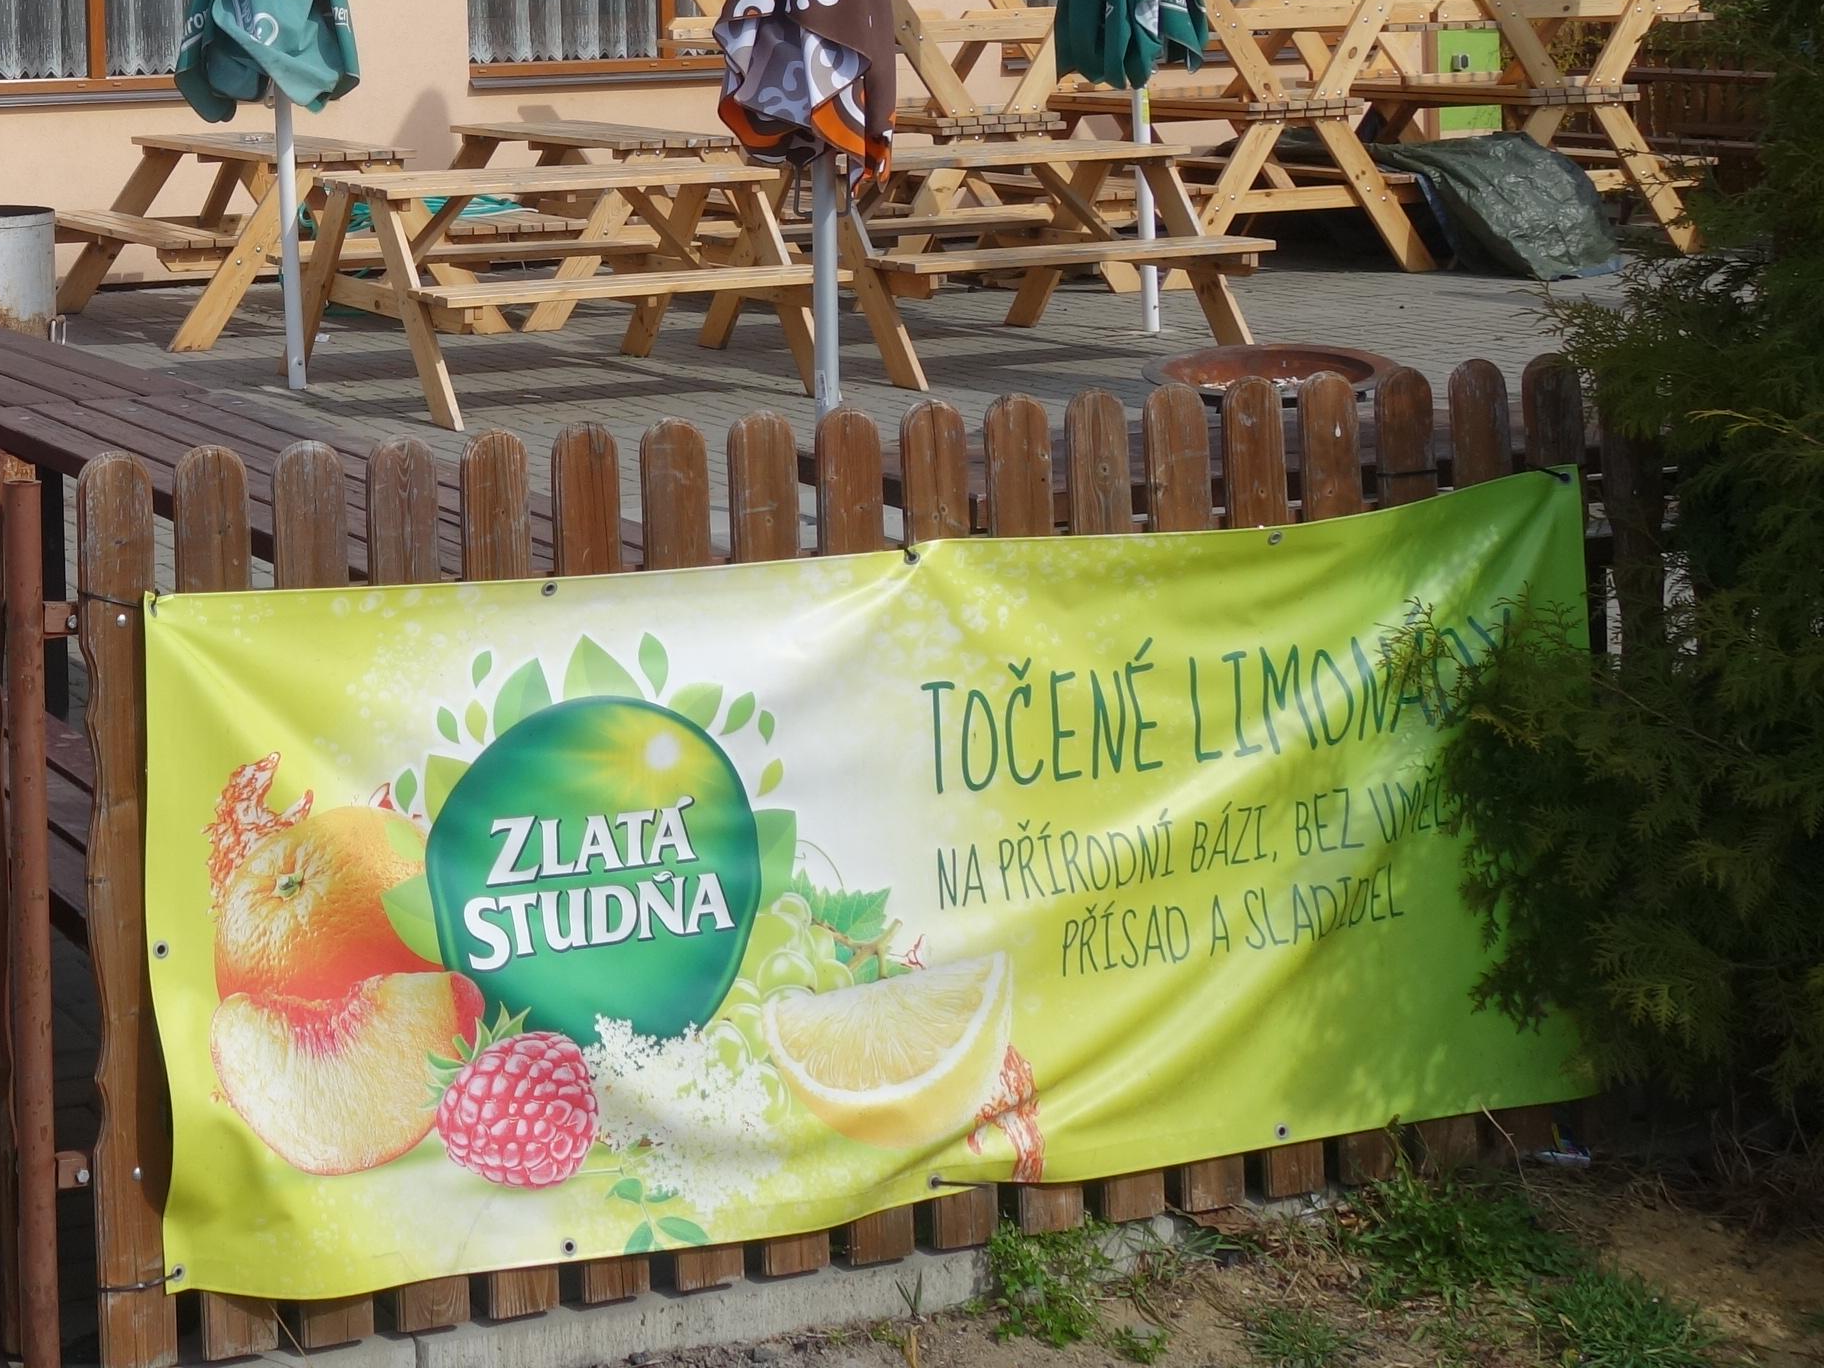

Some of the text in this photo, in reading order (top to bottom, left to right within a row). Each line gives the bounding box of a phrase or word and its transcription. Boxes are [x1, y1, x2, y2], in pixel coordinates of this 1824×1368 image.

[920, 637, 1164, 794] TOČENÉ
[485, 794, 698, 889] ZLATÁ
[937, 843, 987, 910] NA
[998, 807, 1176, 902] PŘÍRODNÍ
[1190, 800, 1278, 873] BÁZI,
[1295, 787, 1365, 857] BEZ
[1061, 861, 1405, 978] PŘÍSAD A SLADIDEL
